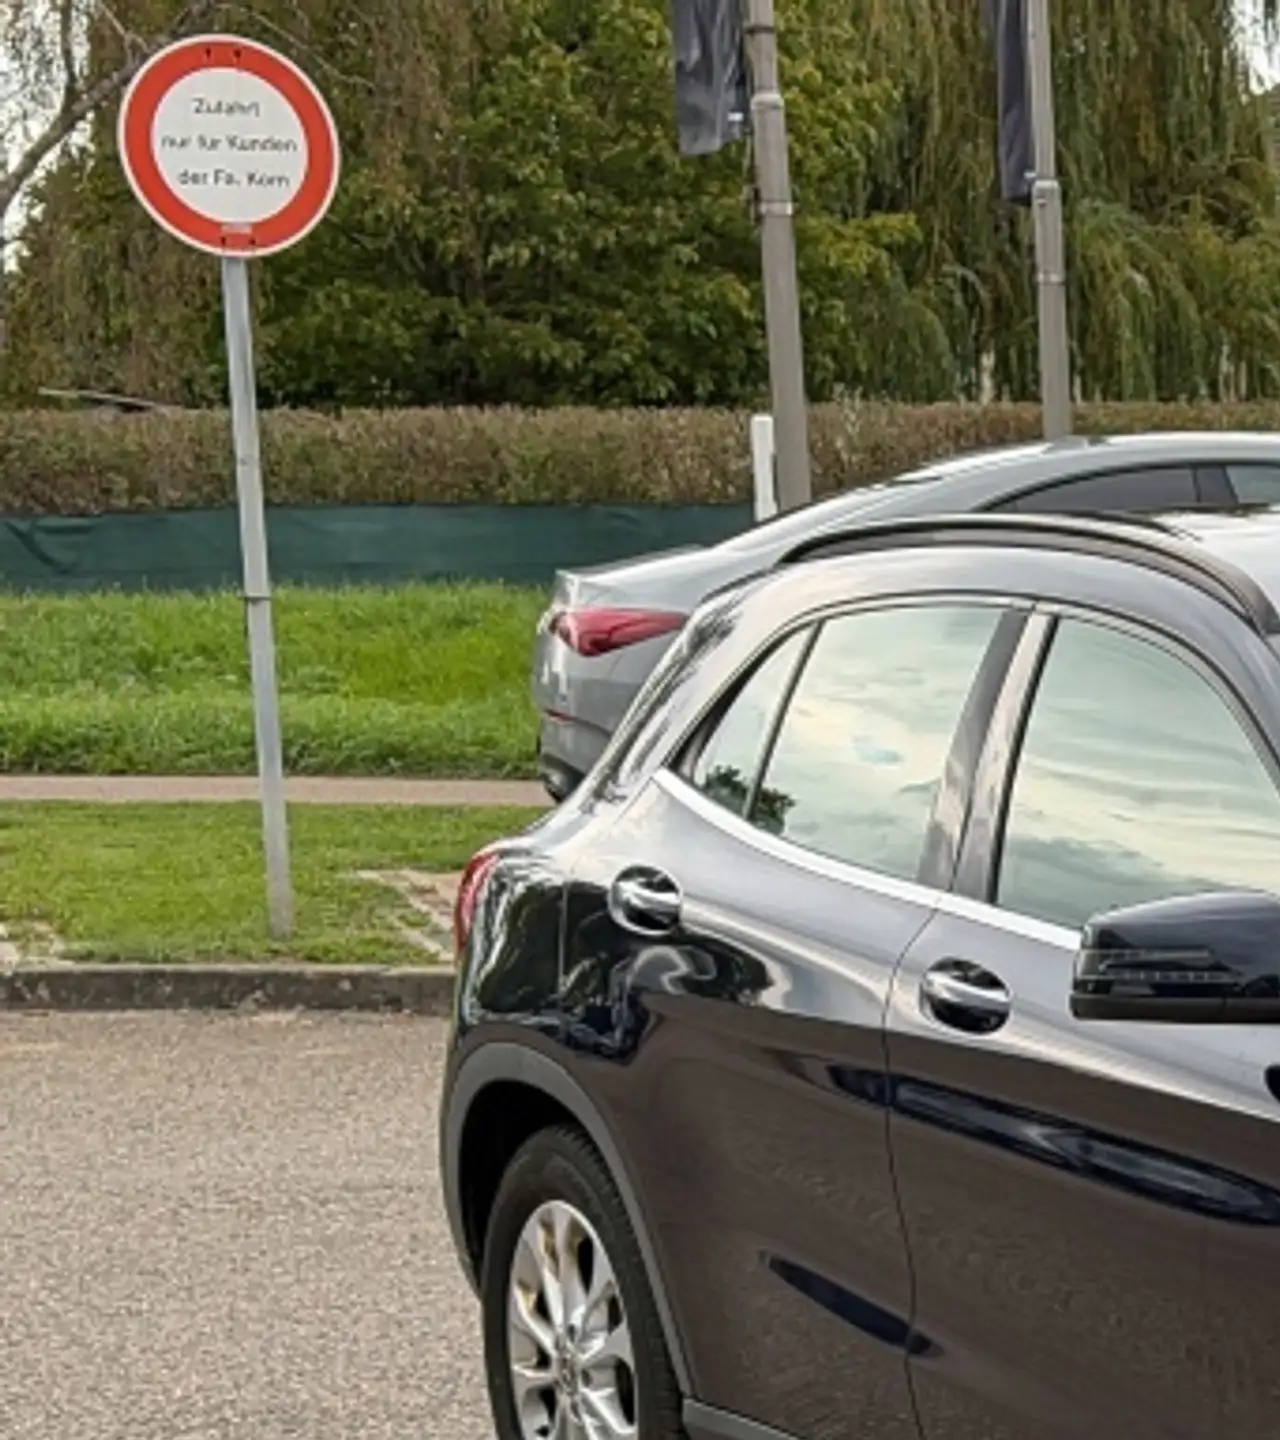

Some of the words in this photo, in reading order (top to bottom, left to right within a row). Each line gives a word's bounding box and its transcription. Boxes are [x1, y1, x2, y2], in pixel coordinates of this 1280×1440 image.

[192, 97, 260, 118] Zufahrt
[160, 134, 191, 149] nur
[226, 134, 297, 152] Kunden
[177, 168, 208, 185] der
[213, 168, 240, 185] Fa.
[246, 169, 290, 187] Korn
